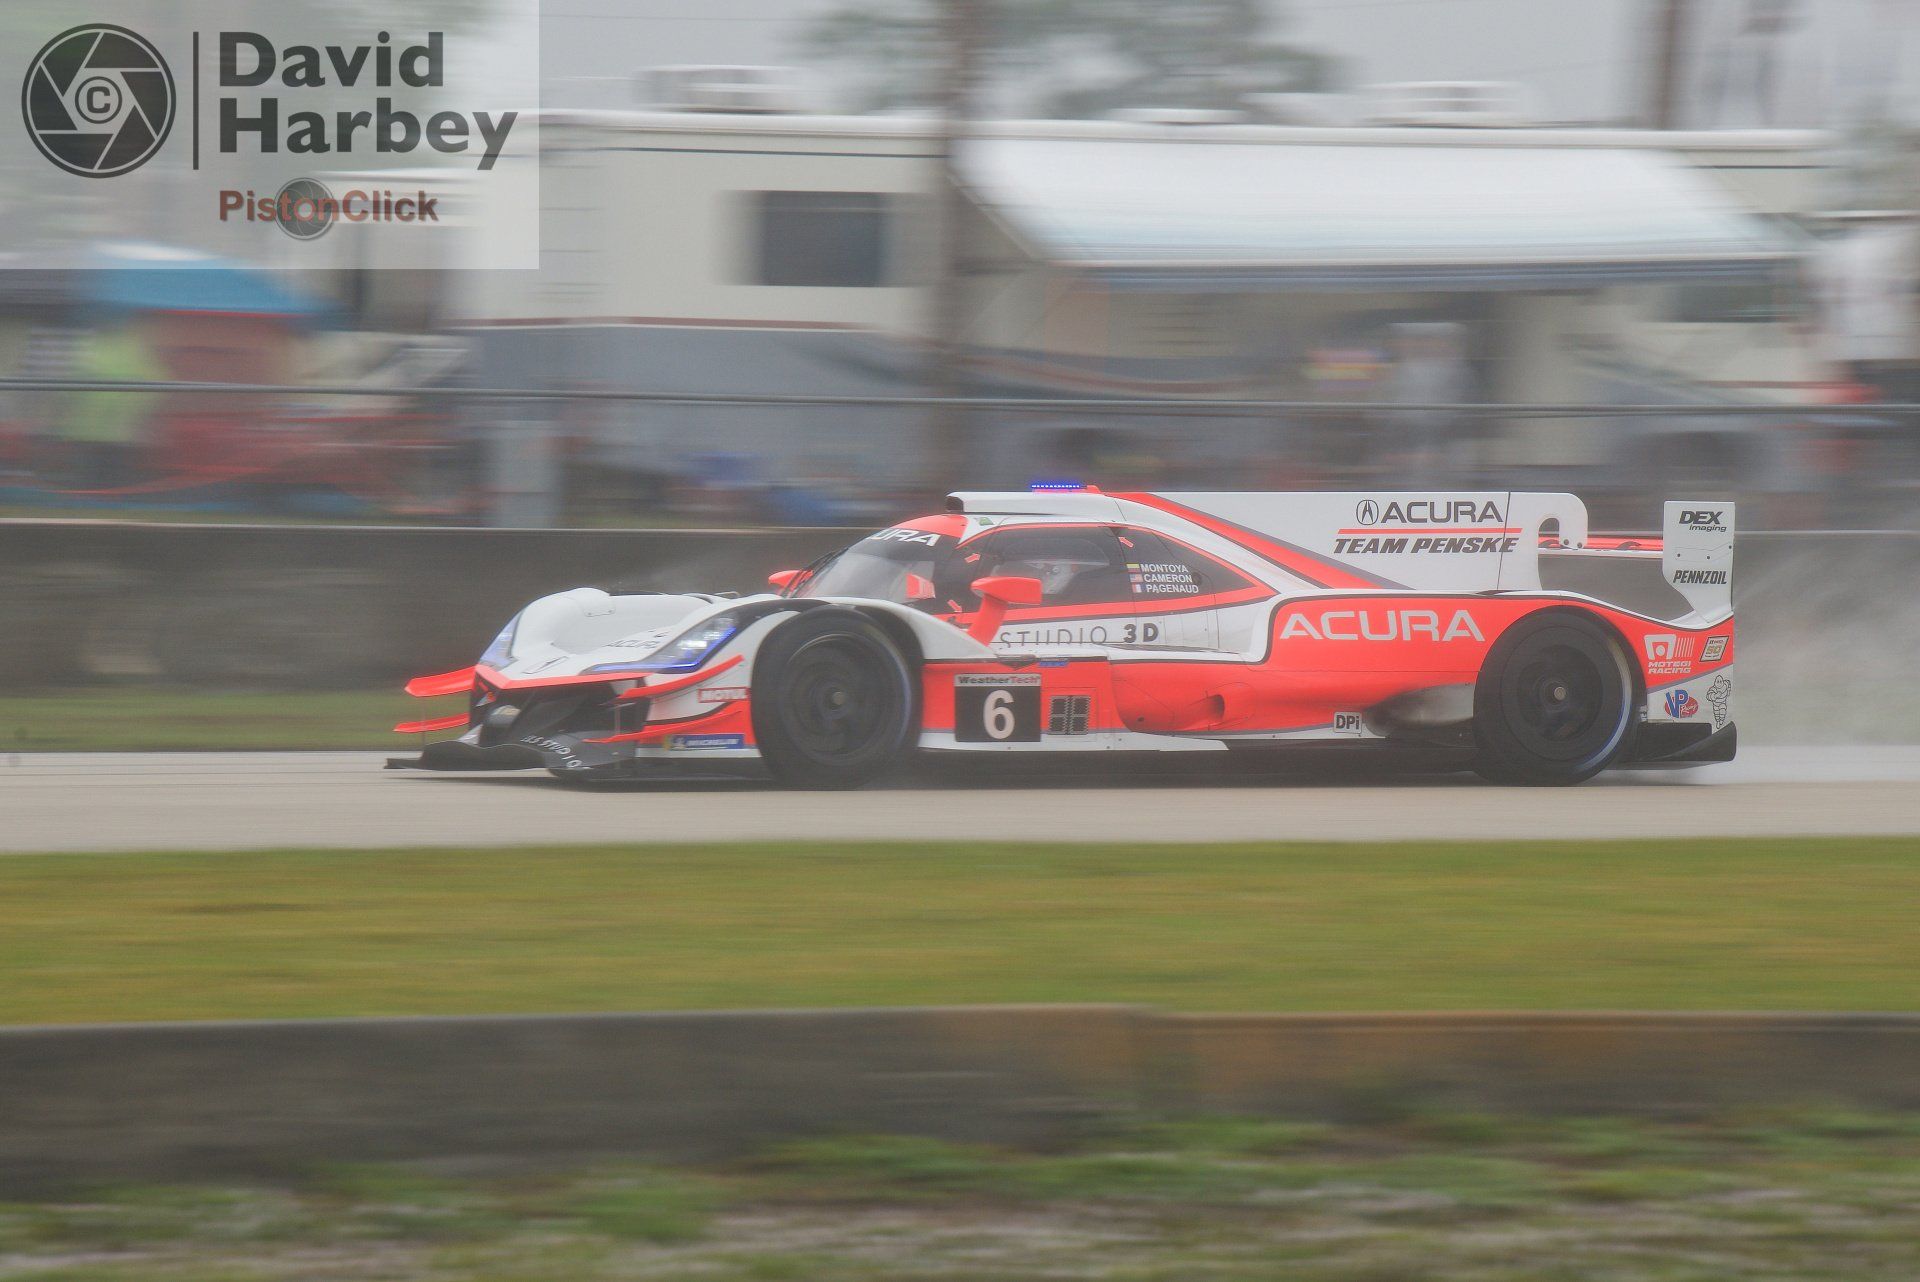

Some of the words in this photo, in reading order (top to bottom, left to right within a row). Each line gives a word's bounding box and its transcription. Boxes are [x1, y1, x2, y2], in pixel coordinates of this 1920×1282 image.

[1381, 501, 1504, 523] ACURA
[1679, 511, 1723, 524] DEX
[1334, 538, 1409, 553] TEAM
[1411, 537, 1519, 553] PENSKE
[1140, 564, 1189, 573] MONTOYA
[1143, 574, 1193, 583] CAMERON
[1673, 570, 1727, 584] PENNZOIL
[1145, 584, 1199, 593] PAGENAUD
[1279, 609, 1486, 641] ACURA
[1000, 626, 1107, 648] STUDIO
[1123, 623, 1159, 643] 3D
[1665, 689, 1689, 718] VP
[983, 689, 1016, 739] 6
[1336, 714, 1360, 729] DPi
